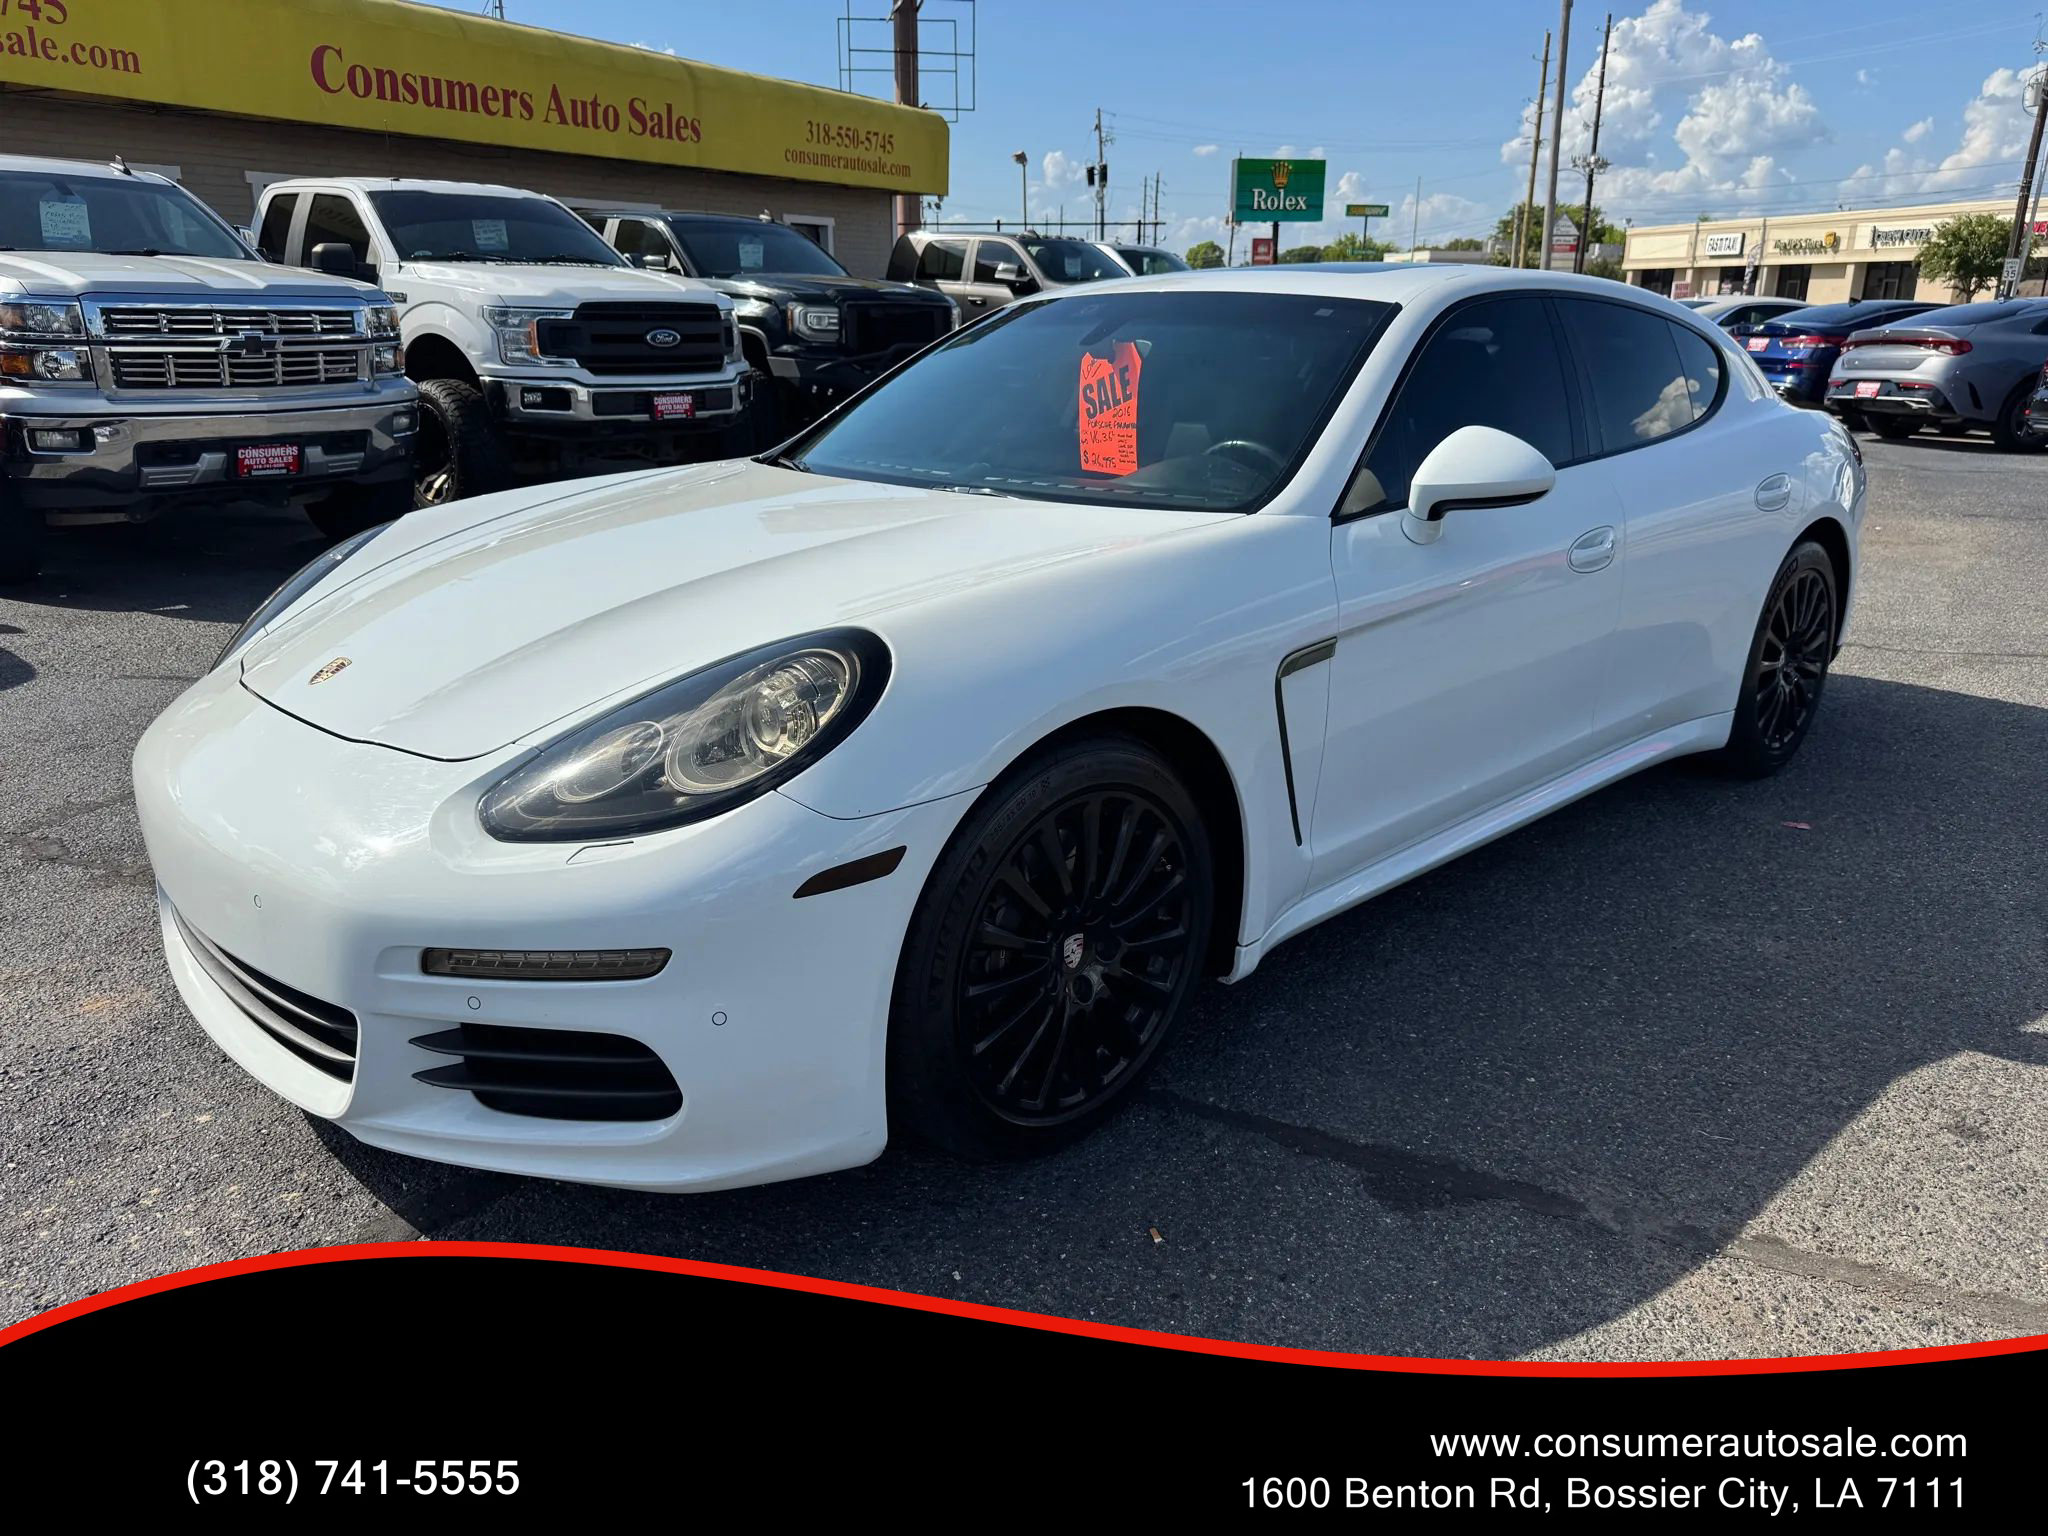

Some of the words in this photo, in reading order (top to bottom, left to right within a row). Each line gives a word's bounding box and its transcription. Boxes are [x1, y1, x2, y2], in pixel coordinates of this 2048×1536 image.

[311, 45, 534, 120] Consumers
[544, 83, 620, 133] Auto
[629, 97, 701, 144] Sales
[805, 120, 895, 155] 318-550-5745
[784, 148, 912, 178] consumerautosale.com
[1252, 188, 1307, 211] Rolex
[2004, 269, 2016, 278] 35
[655, 333, 673, 343] Ford
[653, 396, 692, 404] CONSUMERS
[1083, 365, 1132, 419] SALE
[238, 446, 298, 458] CONSUMERS
[244, 458, 266, 466] AUTO
[268, 456, 293, 464] SALES
